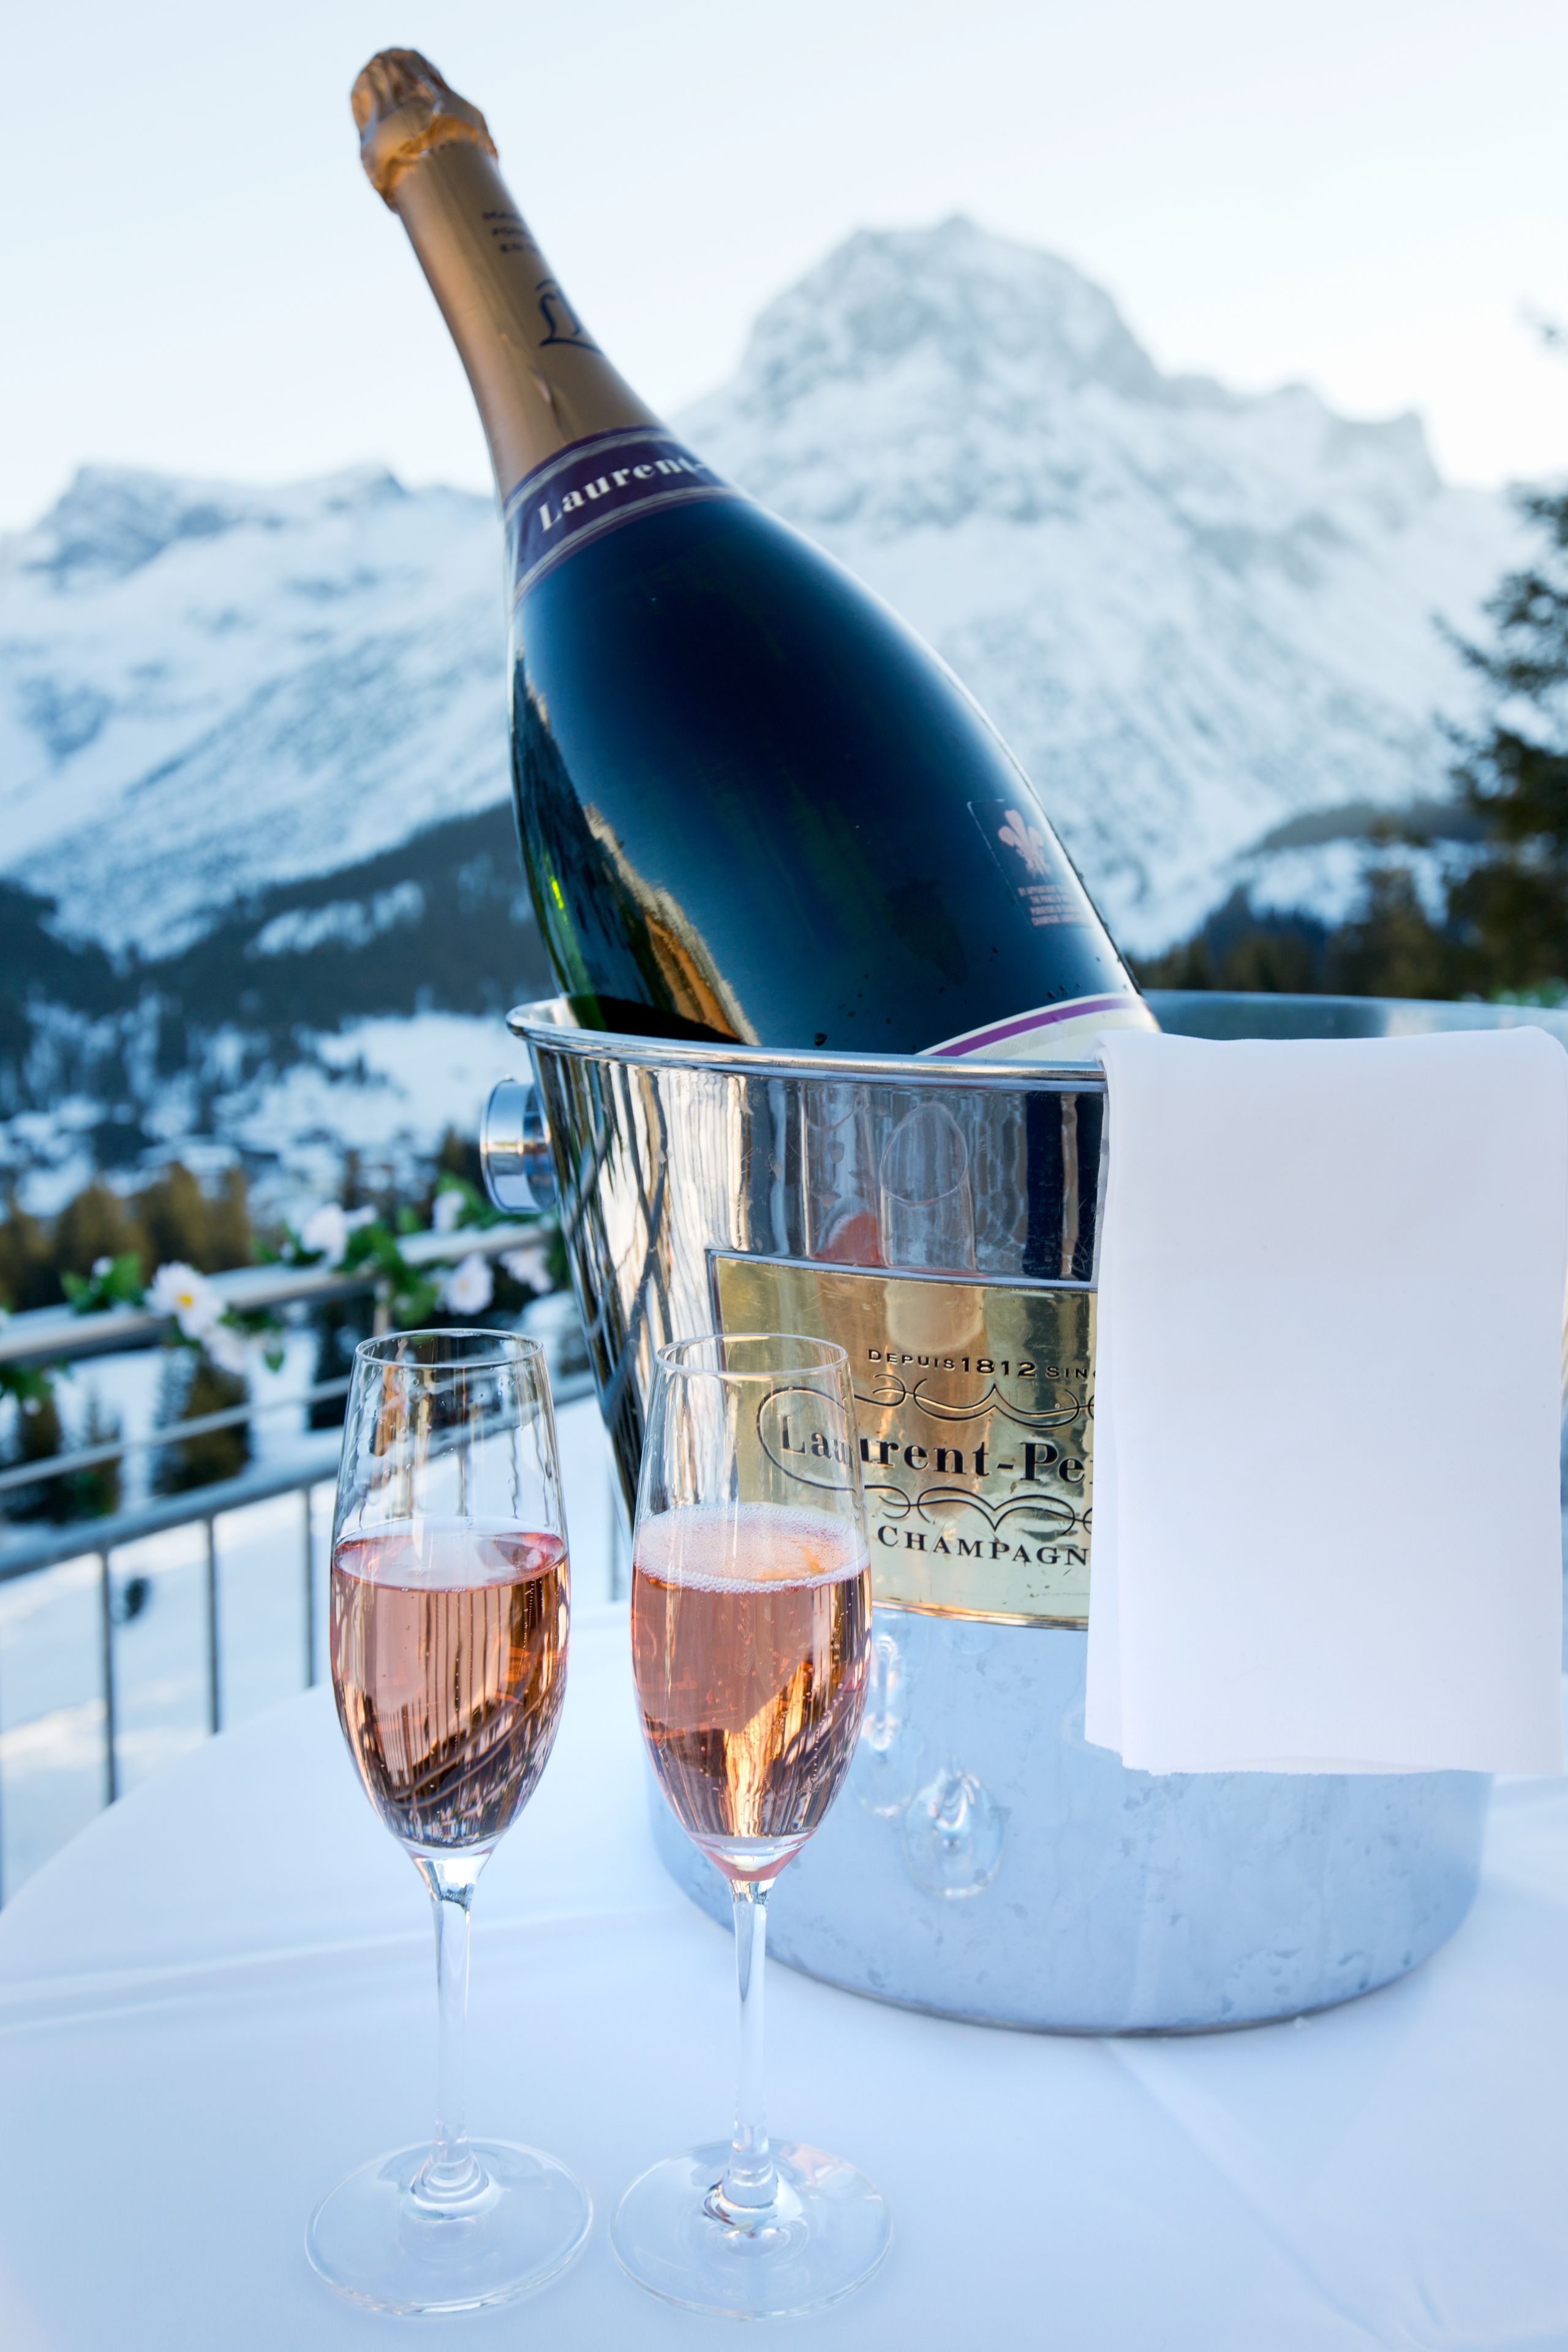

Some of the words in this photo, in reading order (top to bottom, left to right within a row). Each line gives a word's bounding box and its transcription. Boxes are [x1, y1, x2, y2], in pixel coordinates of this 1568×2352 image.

[868, 1349, 955, 1371] DEPUIS
[961, 1357, 1036, 1378] 1812
[1045, 1365, 1096, 1379] SIN
[778, 1414, 1093, 1485] Laurent-Pe
[878, 1525, 1090, 1566] CHAMPAGN
